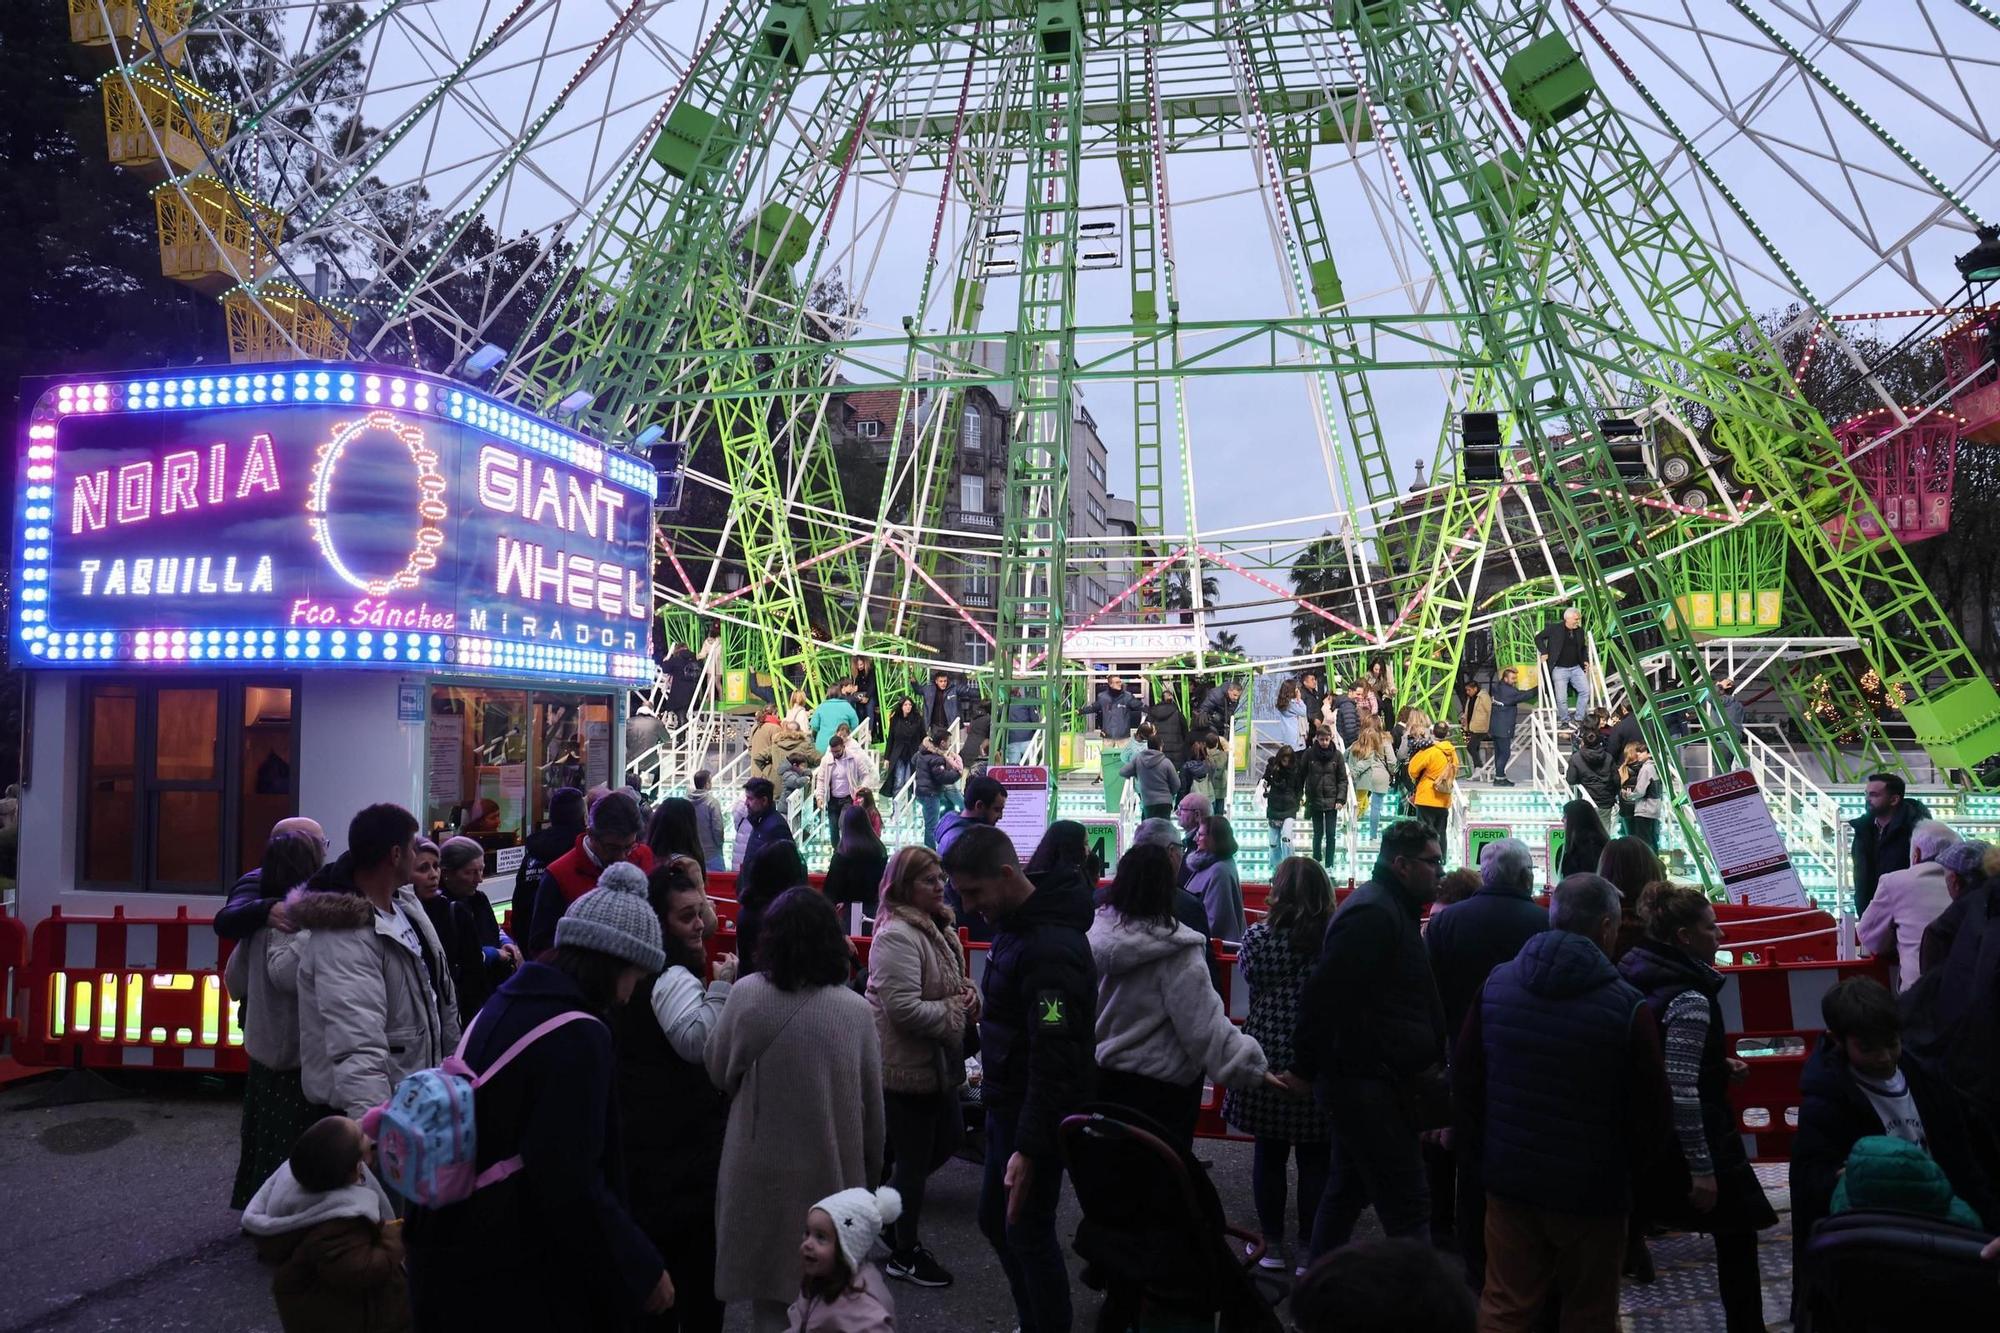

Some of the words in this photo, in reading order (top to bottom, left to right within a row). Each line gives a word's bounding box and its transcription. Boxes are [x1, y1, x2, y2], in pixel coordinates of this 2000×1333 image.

[72, 434, 280, 534] NORIA
[479, 445, 624, 542] GIANT
[80, 556, 273, 595] TAQUILLA
[496, 536, 645, 619] WHEEL
[290, 600, 341, 624] Fco.
[349, 599, 455, 629] Sánchez
[1473, 831, 1505, 839] PUERTA
[1092, 836, 1110, 878] 4
